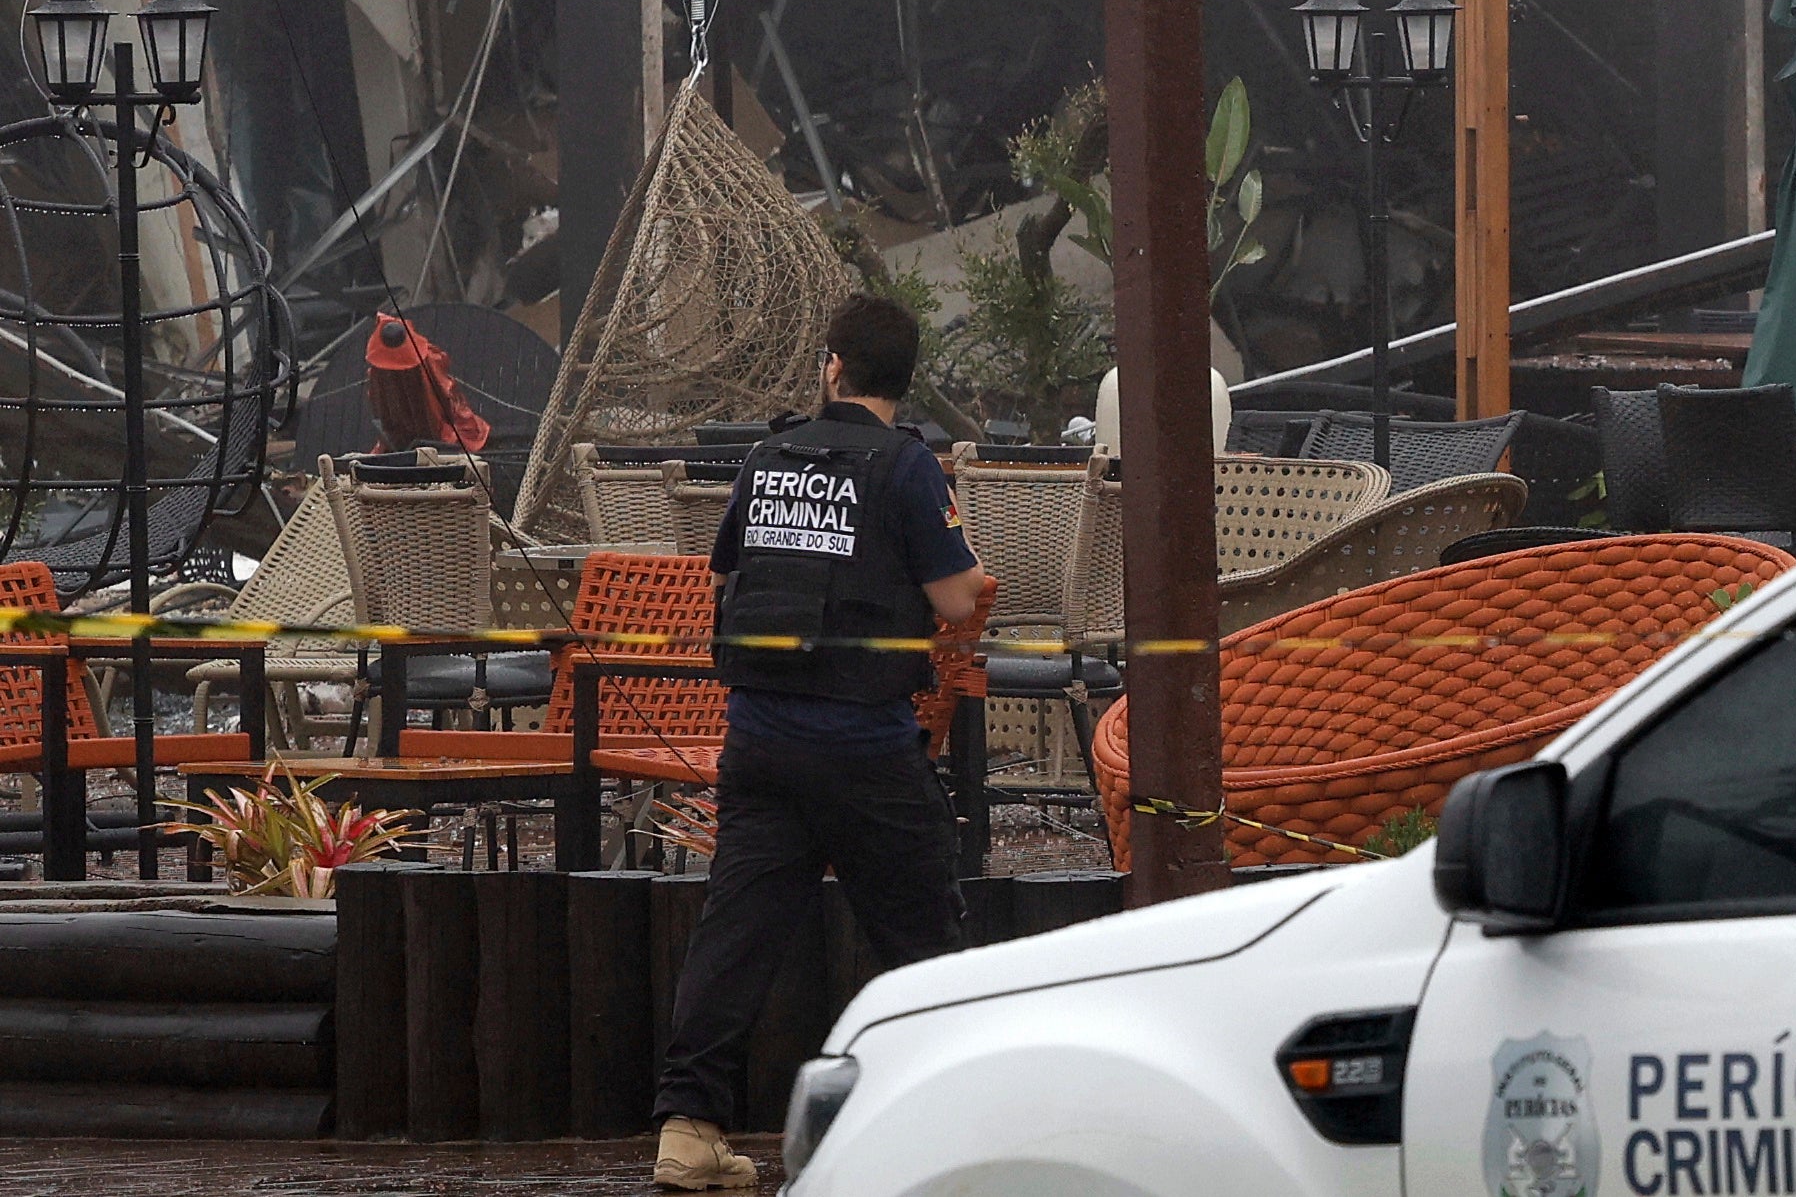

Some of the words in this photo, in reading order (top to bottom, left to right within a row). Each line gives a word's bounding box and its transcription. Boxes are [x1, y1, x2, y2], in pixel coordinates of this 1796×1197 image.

[752, 463, 858, 505] PERÍCIA
[748, 498, 855, 533] CRIMINAL
[762, 529, 803, 547] GRANDE
[806, 533, 824, 549] DO
[828, 535, 851, 554] SUL
